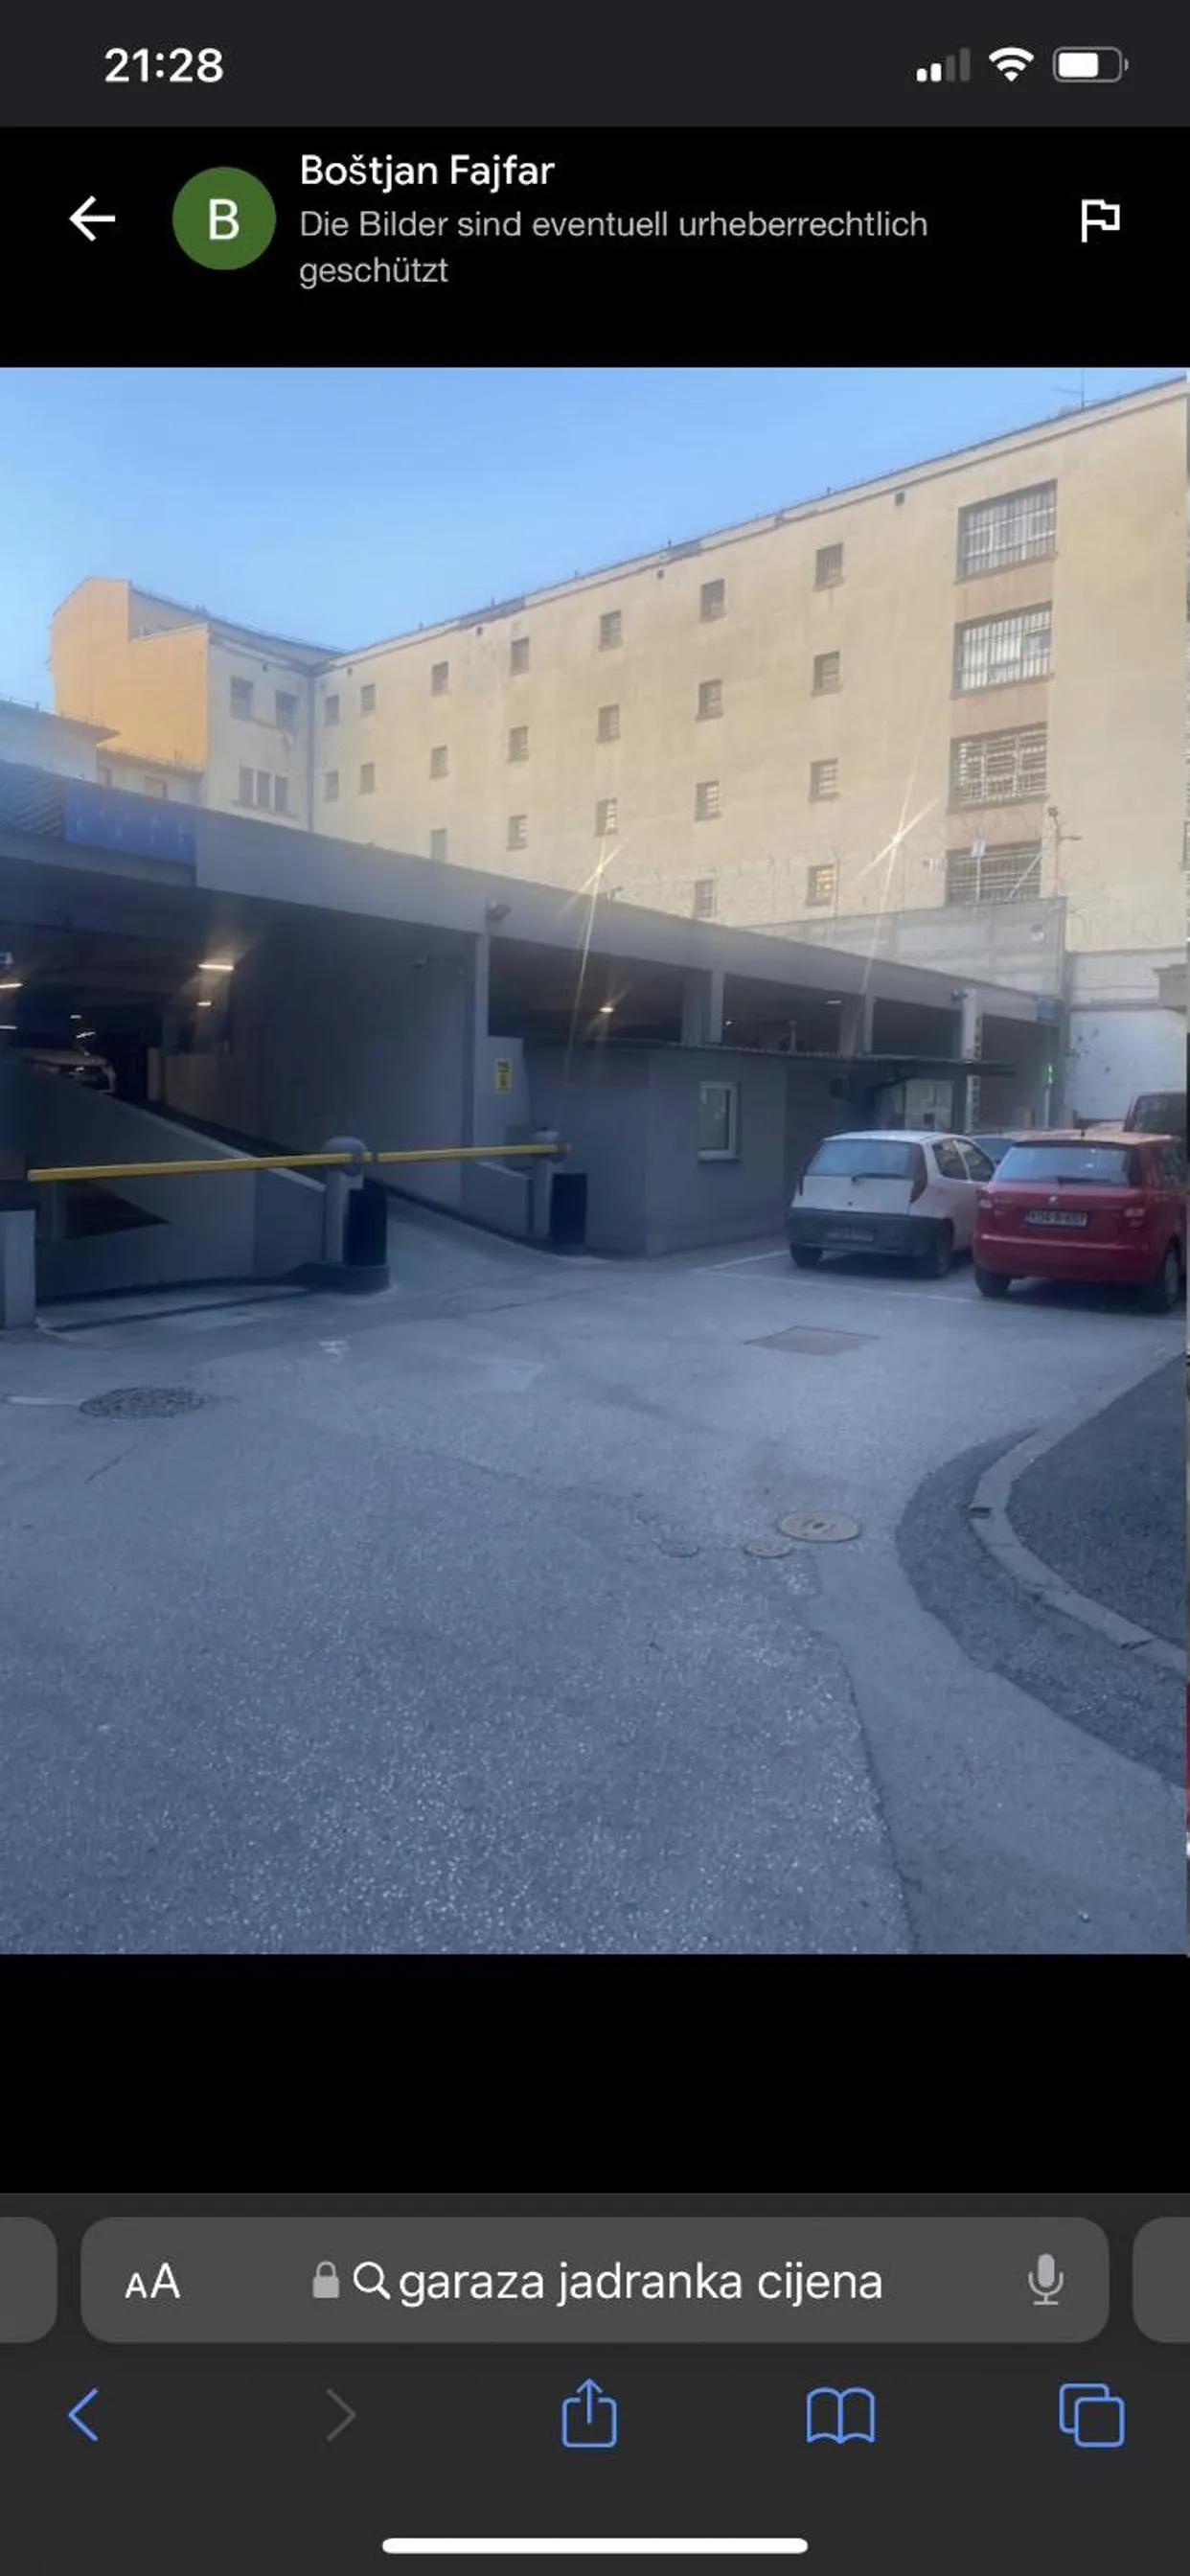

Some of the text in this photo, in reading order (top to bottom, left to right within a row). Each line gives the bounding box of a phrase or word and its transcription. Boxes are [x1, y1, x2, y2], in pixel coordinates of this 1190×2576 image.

[104, 47, 224, 83] 21:28
[301, 153, 556, 194] Boštjan Fajfar
[209, 197, 240, 241] B
[301, 210, 927, 237] Die Bilder sind eventuell urheberrechtlich
[300, 256, 448, 289] geschützt
[125, 2262, 181, 2299] AA
[399, 2261, 882, 2309] garaza jadranka cijena
